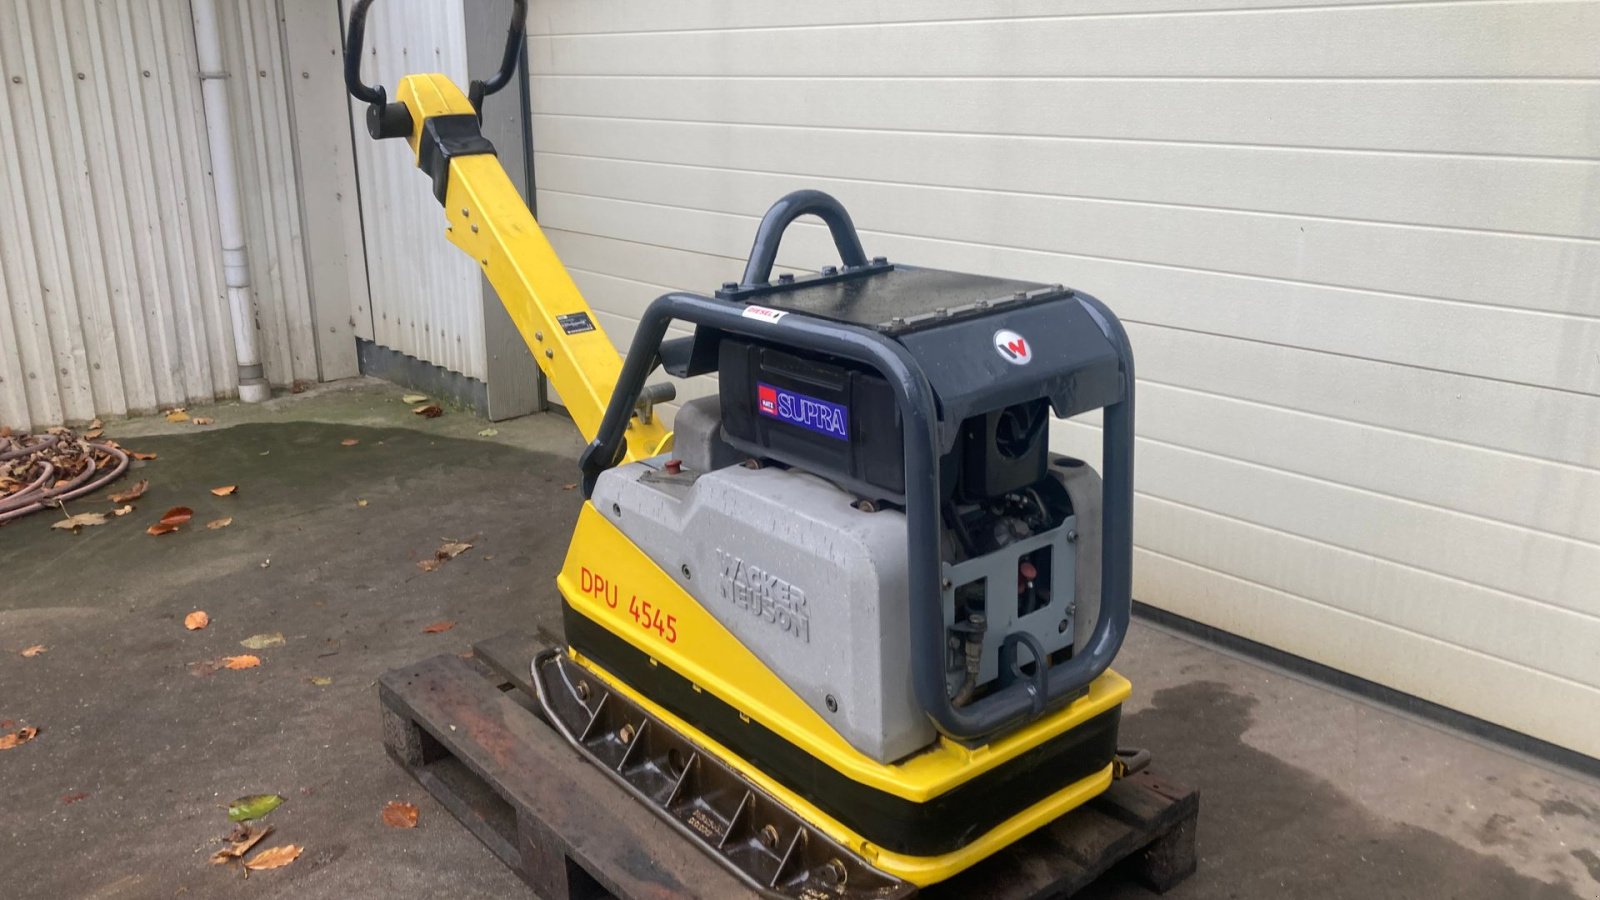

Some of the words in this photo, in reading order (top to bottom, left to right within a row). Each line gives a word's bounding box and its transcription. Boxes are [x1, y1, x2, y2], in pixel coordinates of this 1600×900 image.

[778, 393, 846, 435] SUPRA
[581, 566, 618, 609] DPU
[629, 595, 677, 644] 4545
[716, 548, 807, 616] WACKER
[719, 572, 810, 643] NEUSON
